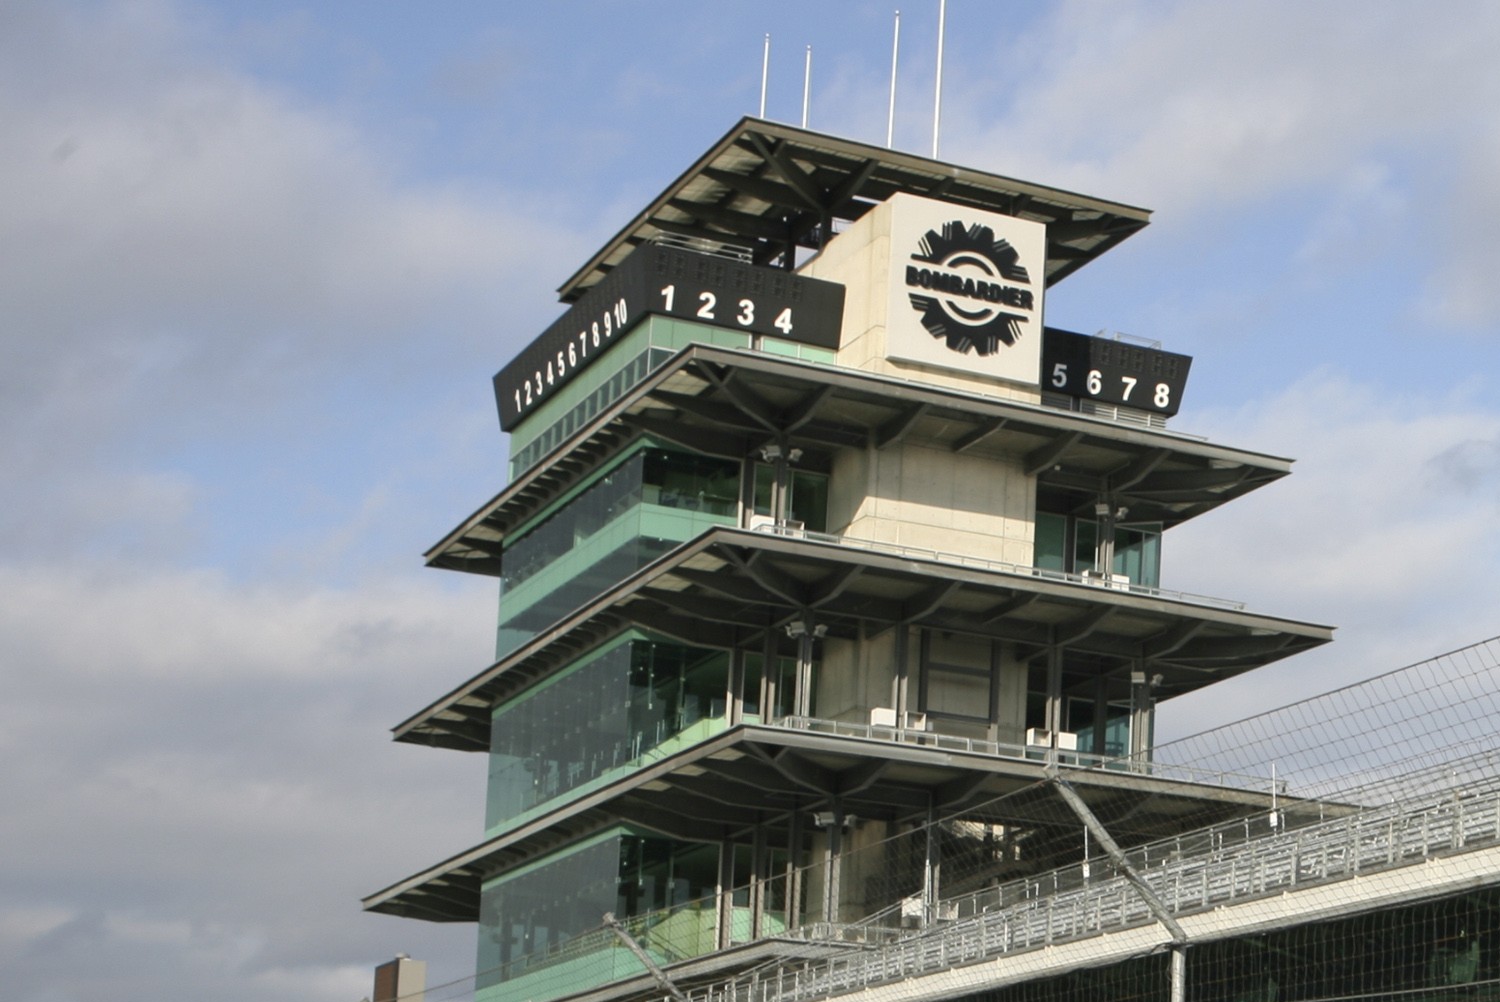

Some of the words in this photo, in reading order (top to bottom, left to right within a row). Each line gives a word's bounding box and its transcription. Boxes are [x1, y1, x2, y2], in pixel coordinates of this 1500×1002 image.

[661, 285, 674, 311] 1
[697, 291, 716, 319] 2
[737, 299, 754, 326] 3
[774, 308, 793, 334] 4
[906, 264, 1034, 312] BOMBARDIER
[515, 389, 521, 412] 1
[525, 380, 532, 406] 2
[536, 371, 543, 395] 3
[547, 361, 554, 385] 4
[557, 351, 565, 377] 5
[568, 342, 576, 367] 6
[580, 331, 587, 357] 7
[592, 321, 600, 347] 8
[604, 311, 612, 337] 9
[614, 298, 627, 328] 10
[1052, 363, 1067, 388] 5
[1087, 369, 1102, 395] 6
[1122, 376, 1137, 401] 7
[1154, 383, 1170, 408] 8
